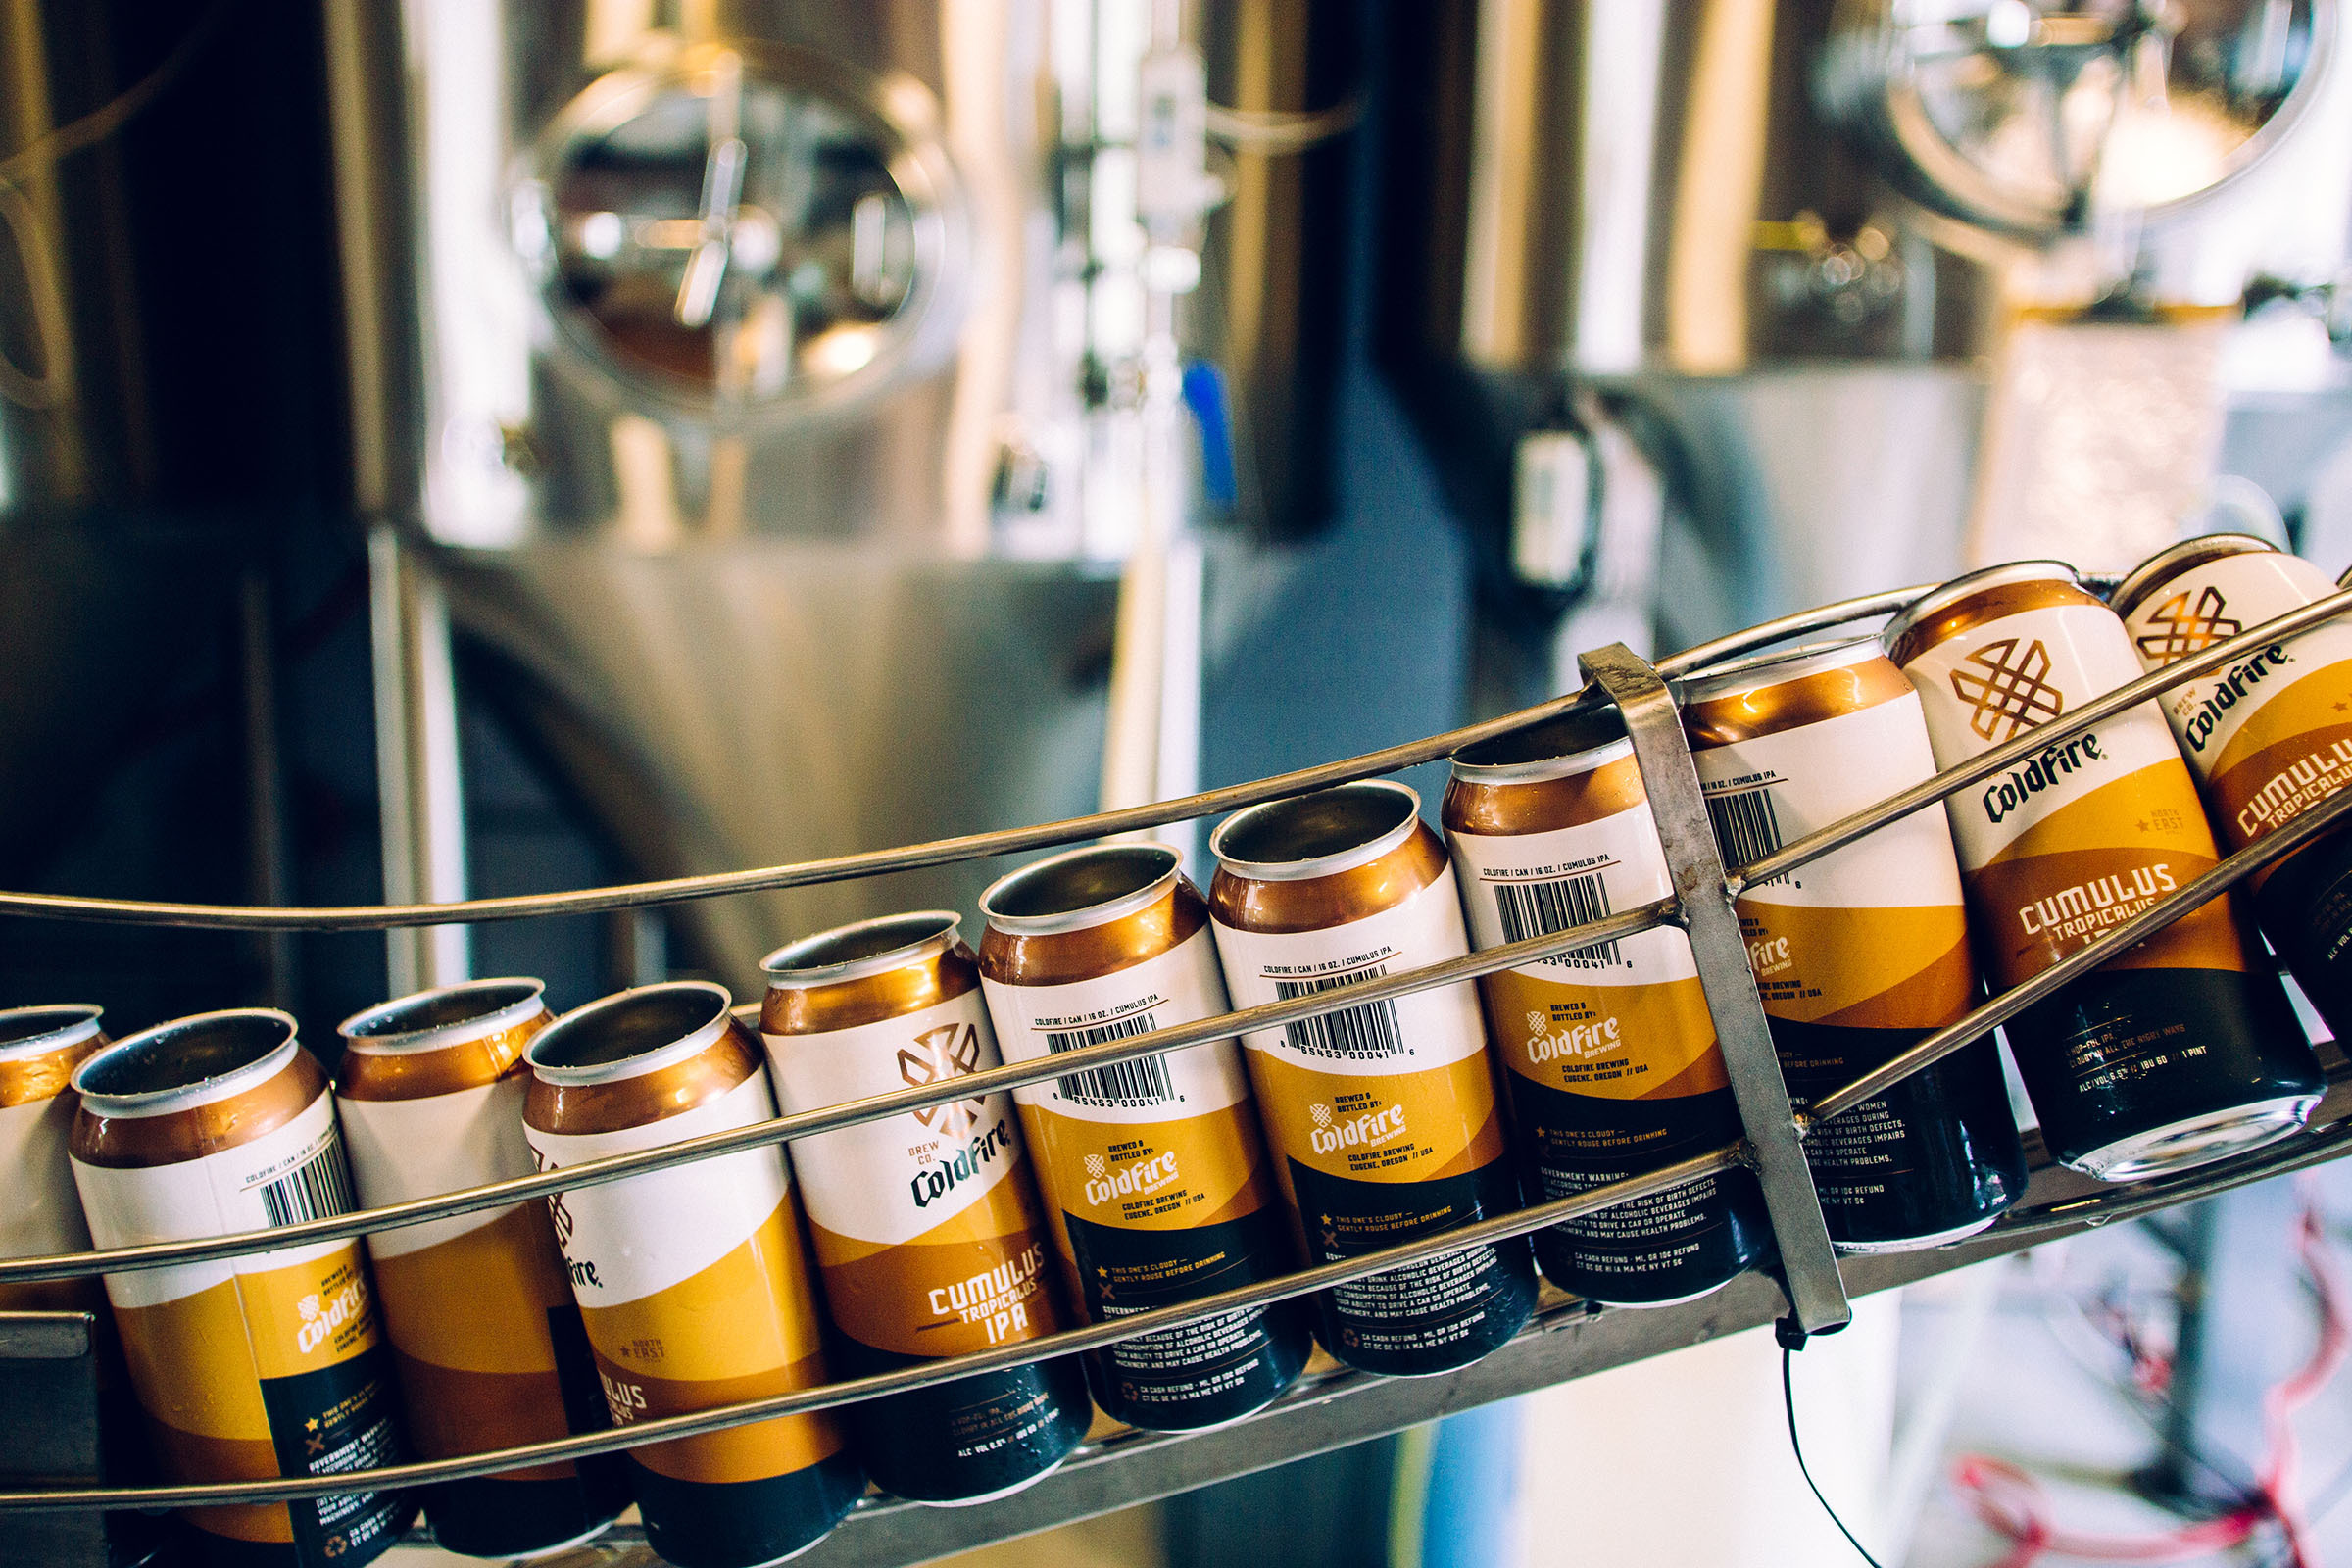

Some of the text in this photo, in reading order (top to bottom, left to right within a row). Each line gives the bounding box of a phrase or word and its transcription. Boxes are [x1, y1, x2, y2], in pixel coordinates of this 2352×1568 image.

[2174, 687, 2196, 716] BREW
[2182, 704, 2198, 717] CO.
[1733, 770, 1776, 785] CUMULUS IPA
[2154, 817, 2184, 830] EAST
[1544, 865, 1556, 874] OZ.
[1562, 858, 1596, 871] CUMULUS
[1597, 854, 1609, 863] IPA
[2019, 864, 2178, 935] CUMULUS
[2053, 898, 2155, 941] TROPICALUS
[1264, 965, 1291, 974] COLDFIRE
[1328, 960, 1341, 969] OZ.
[1347, 950, 1379, 965] CUMULUS
[1380, 946, 1393, 956] IPA
[1772, 980, 1801, 990] BREWING
[1807, 988, 1822, 997] USA
[1035, 1017, 1062, 1026] COLDFIRE
[1115, 999, 1147, 1014] CUMULUS
[1148, 994, 1158, 1004] IPA
[1550, 1004, 1579, 1012] BREWED
[1552, 1012, 1583, 1021] BOTTLED
[1300, 1045, 1341, 1059] 65453
[1349, 1050, 1390, 1059] 00041
[1584, 1039, 1621, 1059] BREWING
[1562, 1058, 1629, 1073] COLDFIRE BREWING
[2140, 1059, 2155, 1070] IBU
[2156, 1055, 2168, 1065] 60
[2187, 1046, 2207, 1056] PINT
[1564, 1064, 1648, 1083] EUGENE, OREGON USA
[1074, 1096, 1114, 1107] 65453
[1121, 1098, 1159, 1107] 00041
[1335, 1093, 1364, 1103] BREWED
[1338, 1102, 1368, 1112] BOTTLED
[1857, 1101, 1886, 1111] WOMEN
[1863, 1111, 1889, 1122] DURING
[1846, 1119, 1905, 1135] BIRTH DEFECTS.
[1371, 1125, 1406, 1147] BREWING
[1602, 1137, 1631, 1147] BEFORE
[1634, 1128, 1667, 1143] DRINKING
[1832, 1130, 1905, 1146] BEVERAGES IMPAIRS
[908, 1141, 940, 1157] BREW
[1108, 1142, 1137, 1153] BREWED
[1110, 1148, 1154, 1162] BOTTLED BY:
[1348, 1143, 1415, 1161] COLDFIRE BREWING
[1836, 1147, 1867, 1155] OPERATE
[283, 1156, 295, 1166] CAN
[918, 1153, 935, 1165] CO.
[1350, 1147, 1433, 1171] EUGENE, OREGON USA
[1851, 1154, 1893, 1166] PROBLEMS.
[1143, 1171, 1179, 1195] BREWING
[1667, 1190, 1687, 1201] BIRTH
[1689, 1178, 1717, 1195] DEFECTS.
[1855, 1185, 1884, 1194] REFUND
[1122, 1190, 1188, 1211] COLDFIRE BREWING
[1125, 1193, 1205, 1220] EUGENE, OREGON USA
[1611, 1188, 1717, 1219] ALCOHOLIC BEVERAGES IMPAIRS
[1375, 1212, 1402, 1223] CLOUDY
[1391, 1218, 1418, 1230] BEFORE
[1421, 1205, 1452, 1222] DRINKING
[1655, 1210, 1686, 1224] OPERATE
[1617, 1230, 1640, 1239] CAUSE
[1642, 1225, 1668, 1236] HEALTH
[1670, 1213, 1706, 1231] PROBLEMS.
[1673, 1243, 1700, 1256] REFUND
[1151, 1259, 1178, 1271] CLOUDY
[1165, 1264, 1193, 1277] BEFORE
[1195, 1251, 1225, 1269] DRINKING
[1661, 1260, 1670, 1269] VT
[928, 1242, 1045, 1315] CUMULUS
[959, 1277, 1037, 1324] TROPICALUS
[984, 1302, 1029, 1344] IPA
[632, 1346, 665, 1359] EAST
